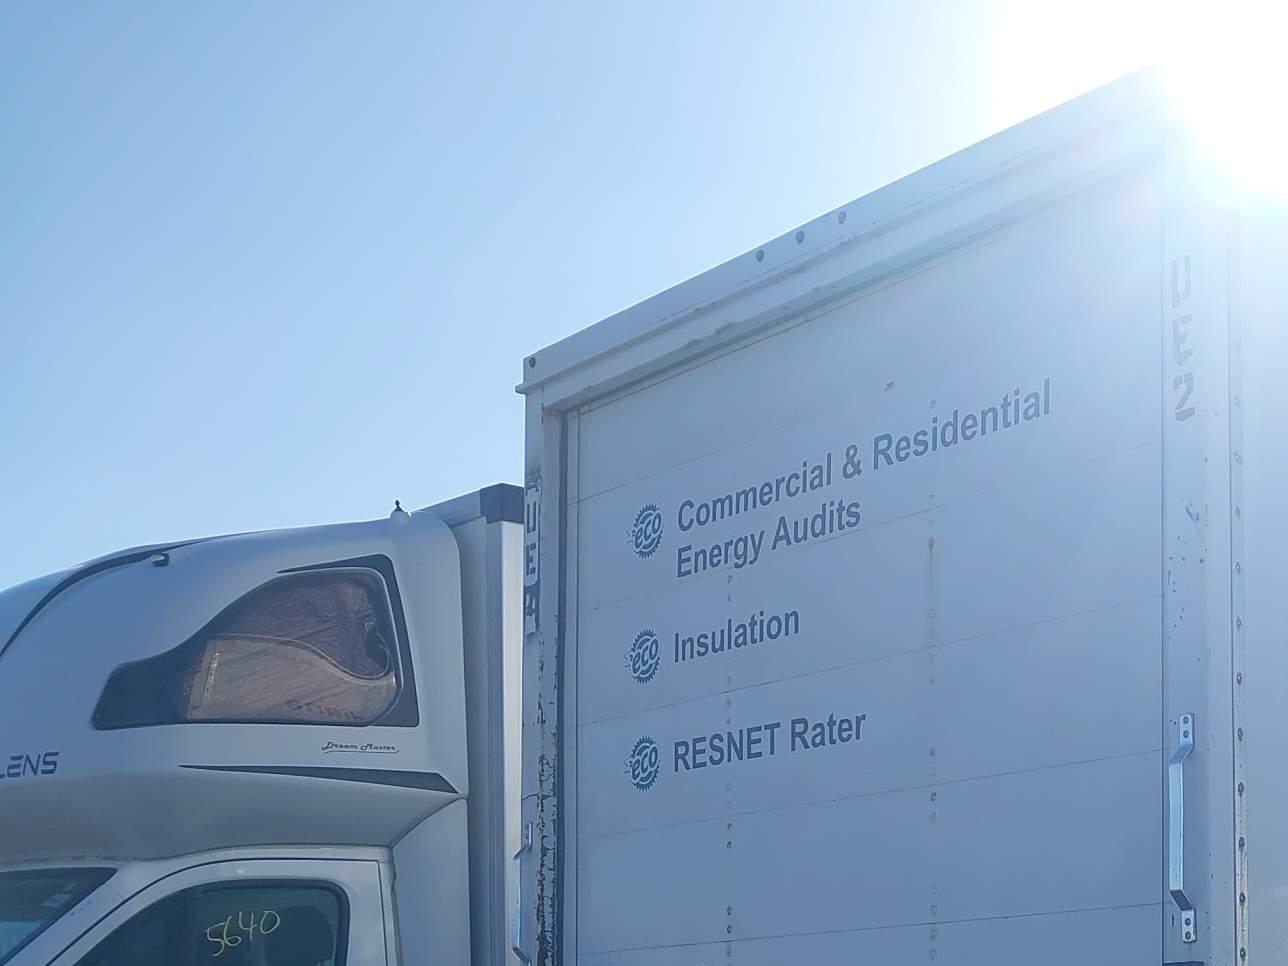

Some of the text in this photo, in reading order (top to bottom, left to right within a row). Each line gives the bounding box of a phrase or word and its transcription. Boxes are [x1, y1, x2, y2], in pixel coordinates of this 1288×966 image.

[676, 378, 1051, 532] Commercial & Residential
[676, 500, 862, 578] Energy Audits
[673, 609, 800, 664] Insulation
[321, 741, 397, 752] Dream Master
[673, 712, 867, 773] RESNET Rater
[206, 910, 281, 957] 5640
